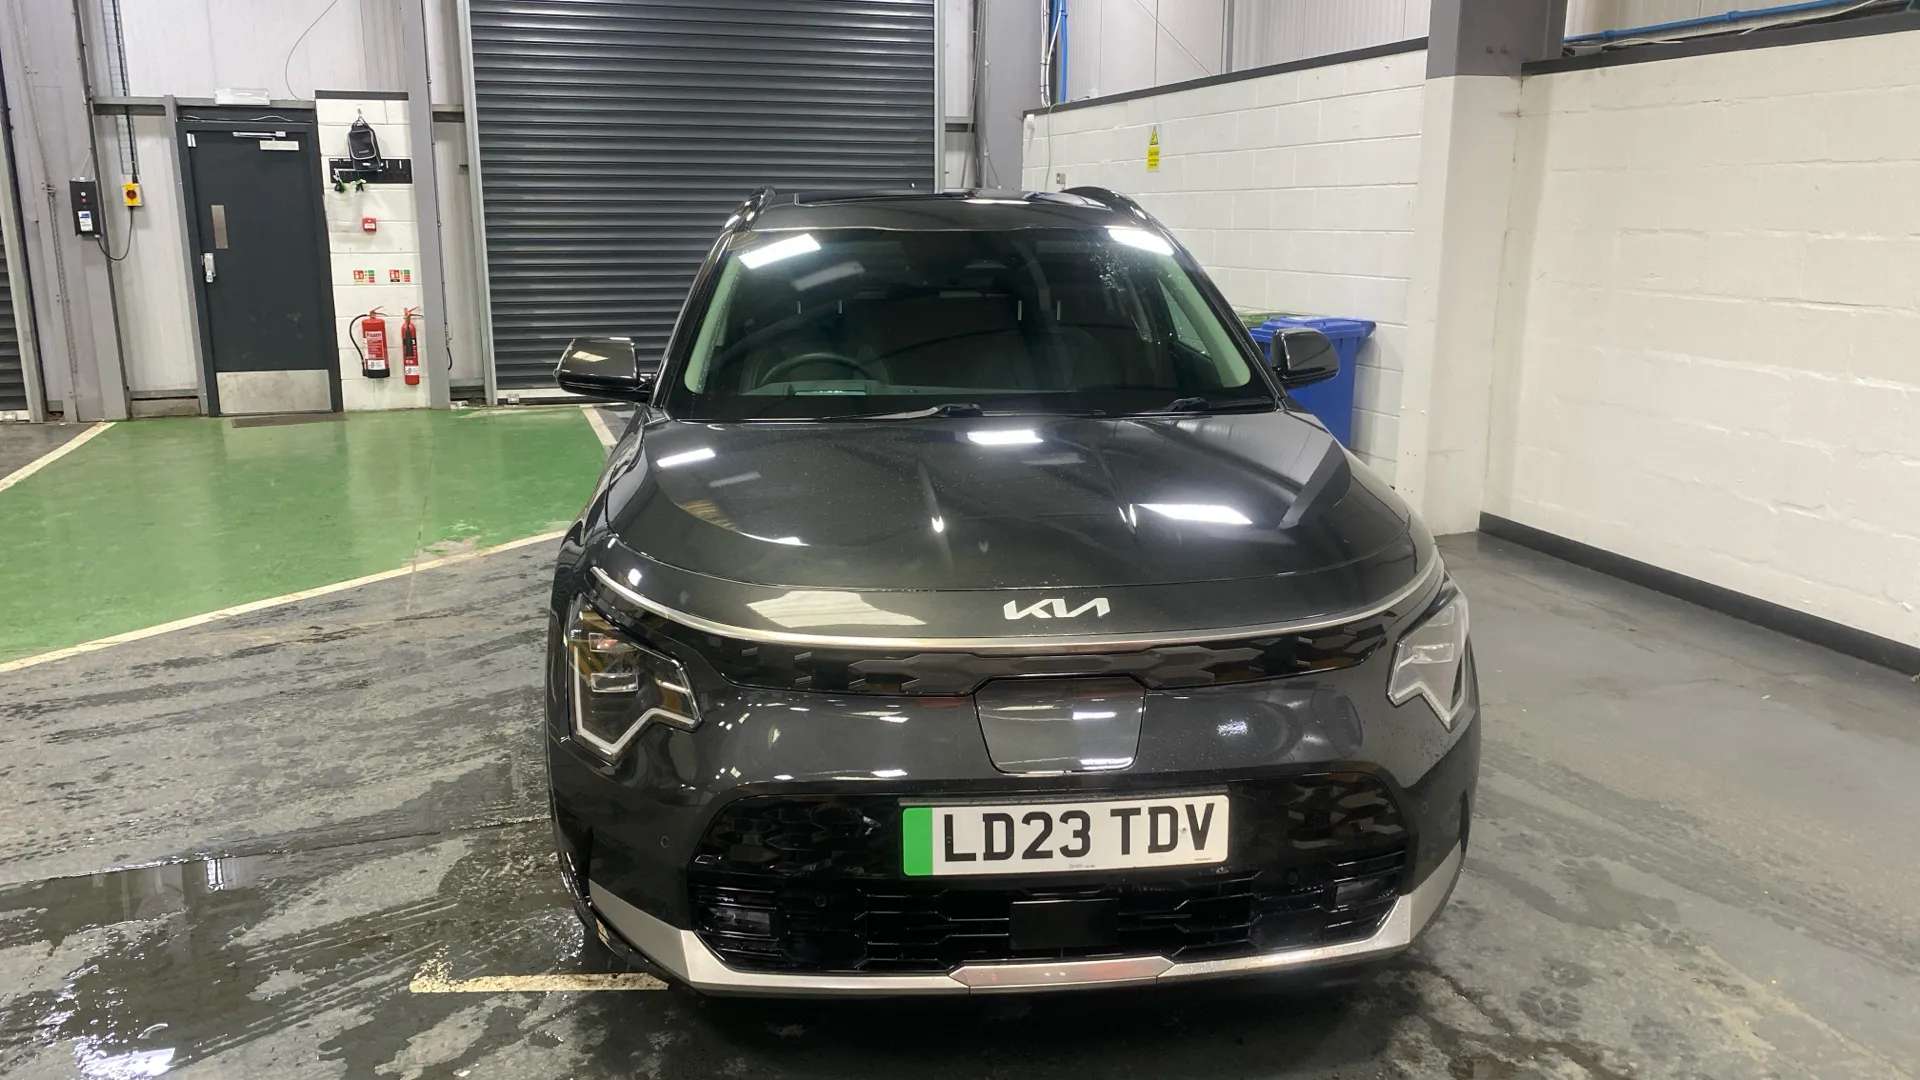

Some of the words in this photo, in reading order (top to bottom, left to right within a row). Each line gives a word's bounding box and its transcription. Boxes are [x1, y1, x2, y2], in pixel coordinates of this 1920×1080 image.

[1003, 597, 1110, 620] KIA
[944, 810, 1091, 862] LD23
[1110, 803, 1215, 855] TDV
